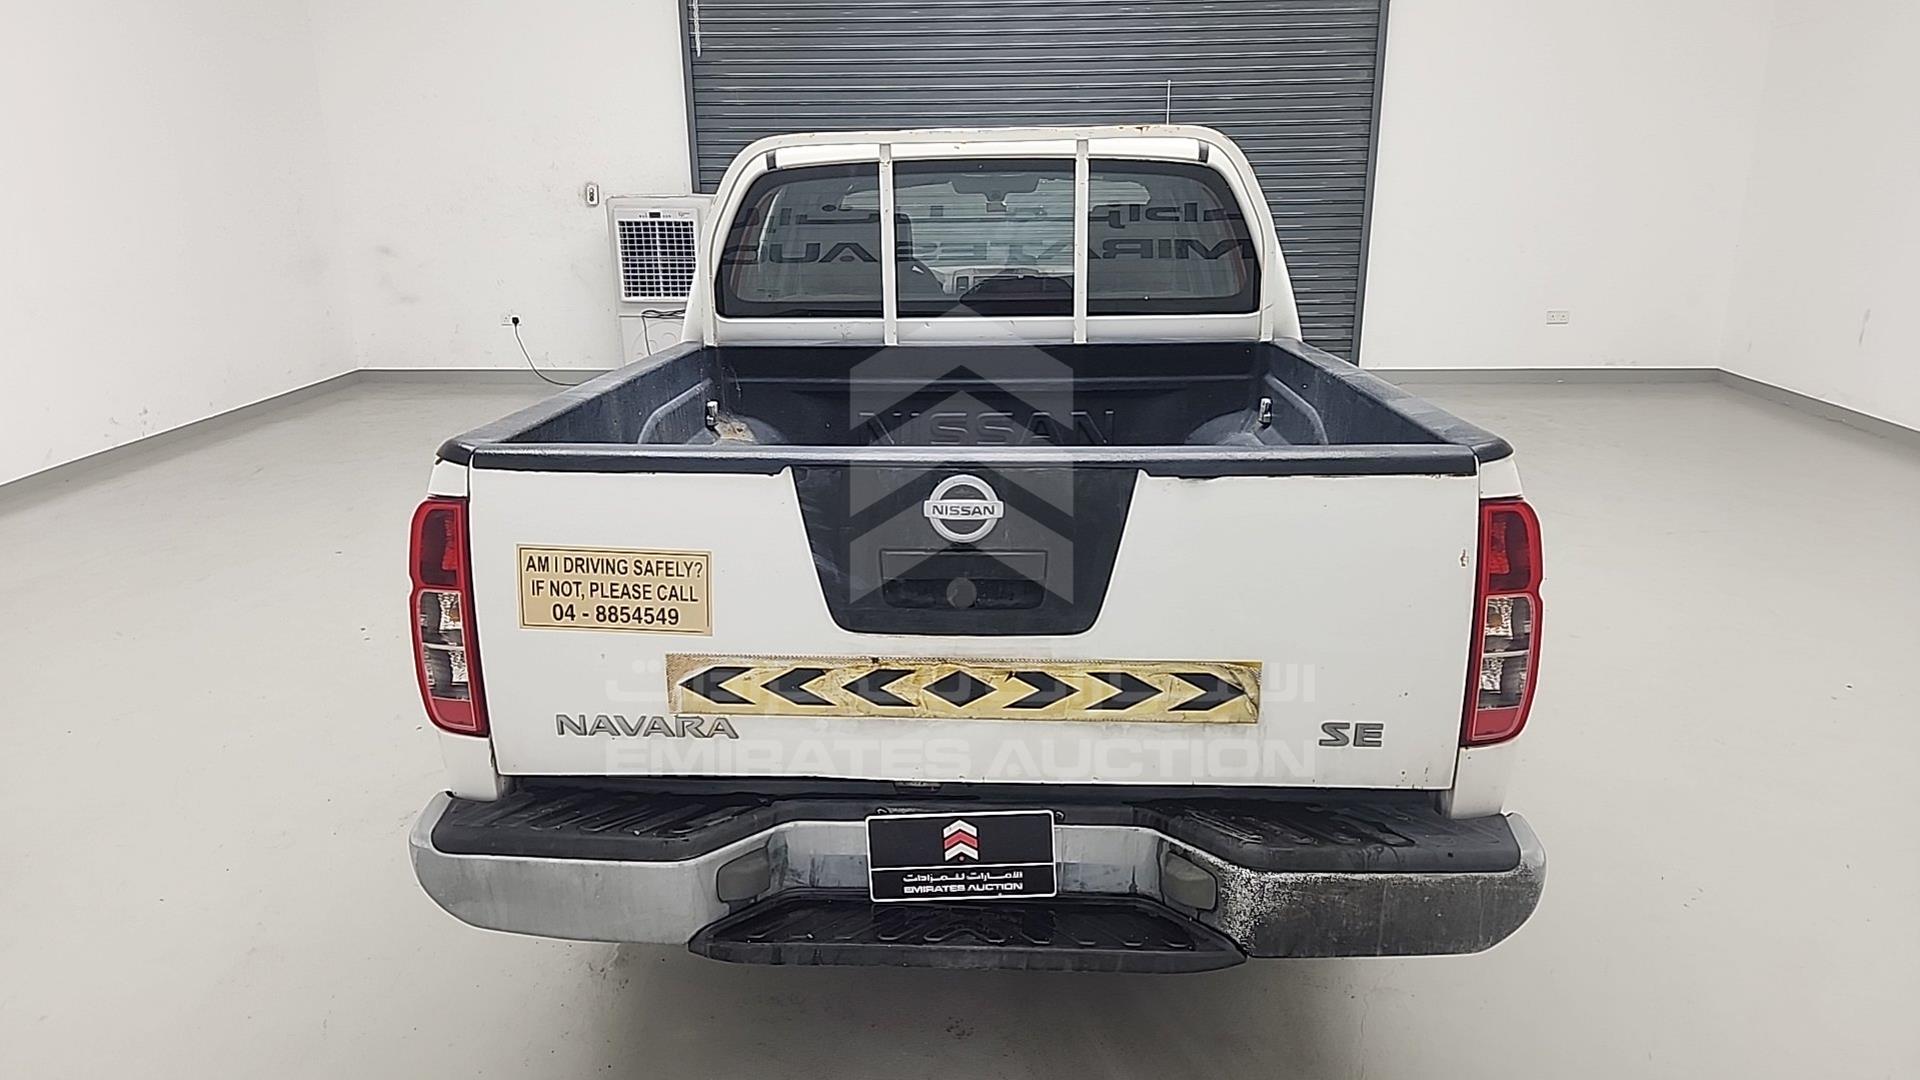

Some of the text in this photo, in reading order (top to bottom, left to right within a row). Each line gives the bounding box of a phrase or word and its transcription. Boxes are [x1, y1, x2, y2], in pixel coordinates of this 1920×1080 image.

[858, 411, 1113, 445] NISSAN
[931, 504, 995, 517] NISSAN
[525, 555, 704, 578] AM I DRIVING SAFELY?
[531, 580, 699, 602] IF NOT, PLEASE CALL
[552, 603, 575, 622] 04
[595, 606, 680, 626] 8854549
[555, 714, 739, 739] NAVARA
[1319, 722, 1385, 748] SE
[903, 882, 1023, 894] EMIRATES AUCTION
